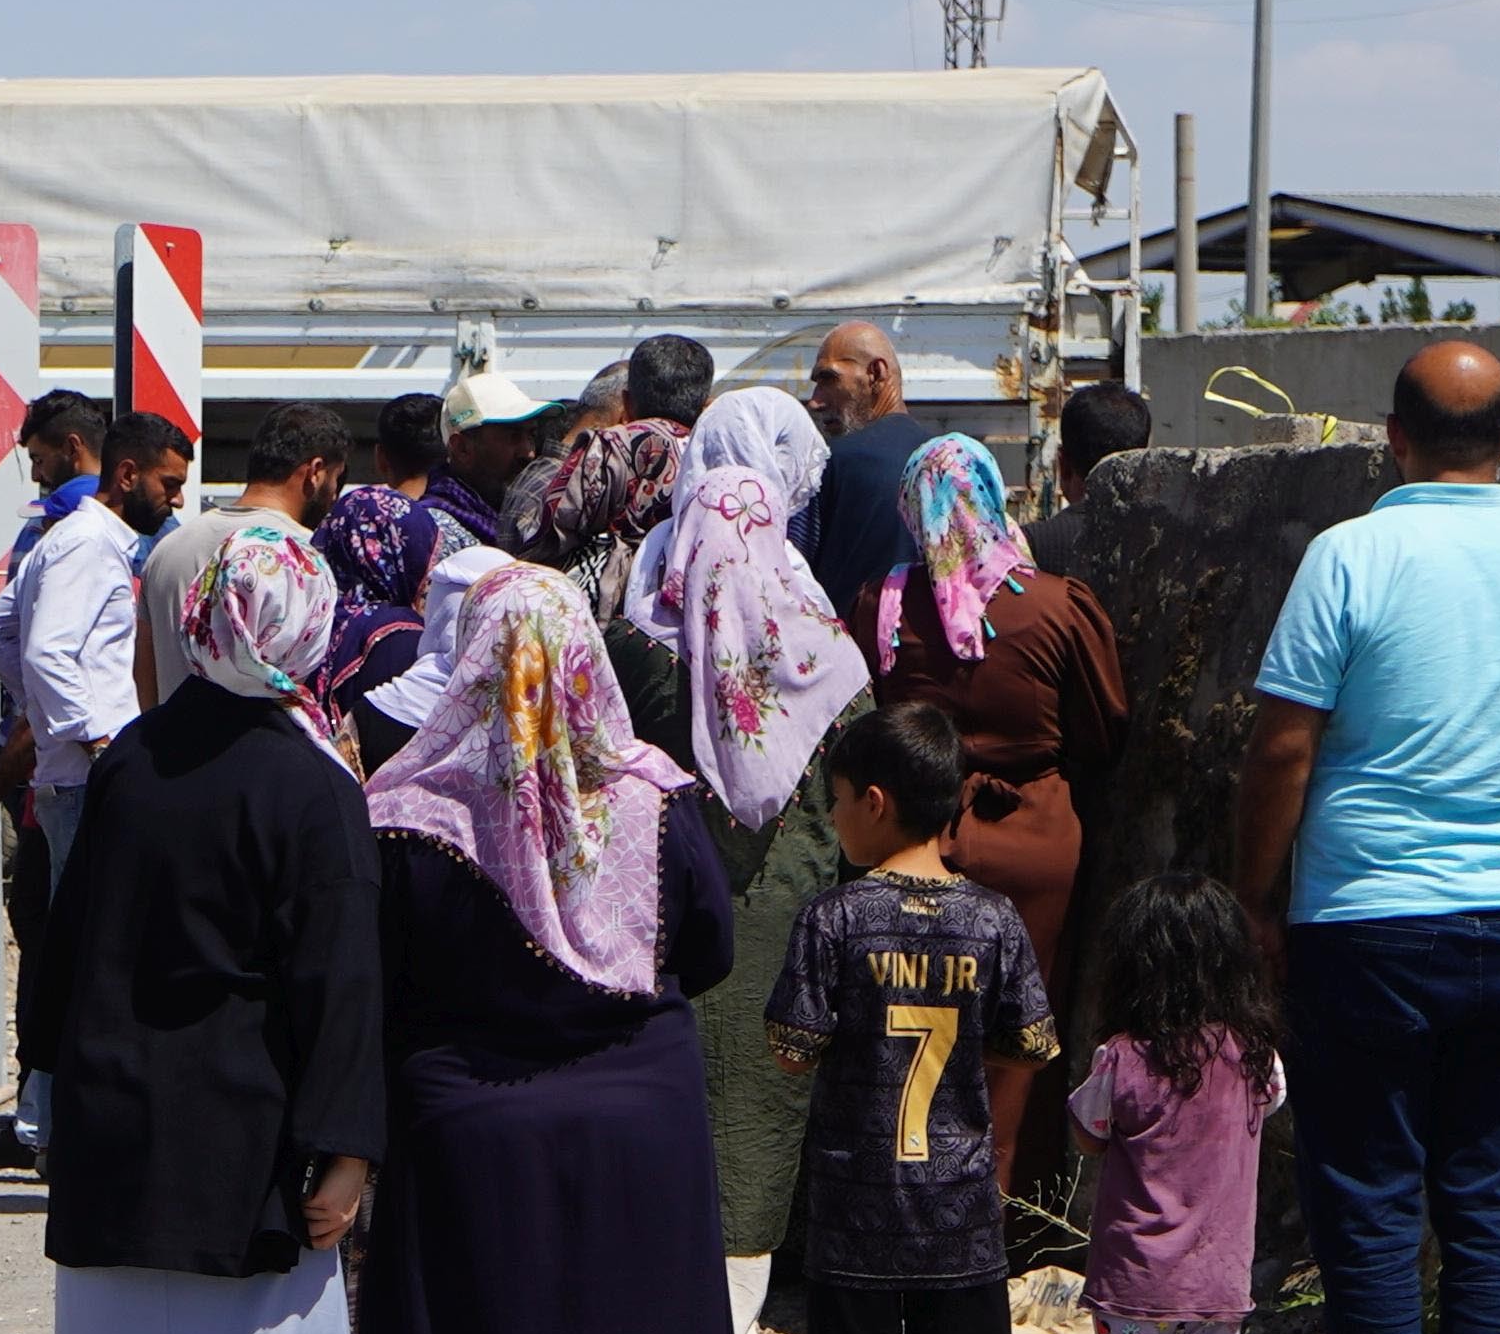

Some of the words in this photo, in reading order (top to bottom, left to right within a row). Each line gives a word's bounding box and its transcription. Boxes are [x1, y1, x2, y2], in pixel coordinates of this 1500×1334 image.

[867, 951, 929, 989] VINI
[942, 954, 981, 997] JR.
[886, 1005, 959, 1161] 7
